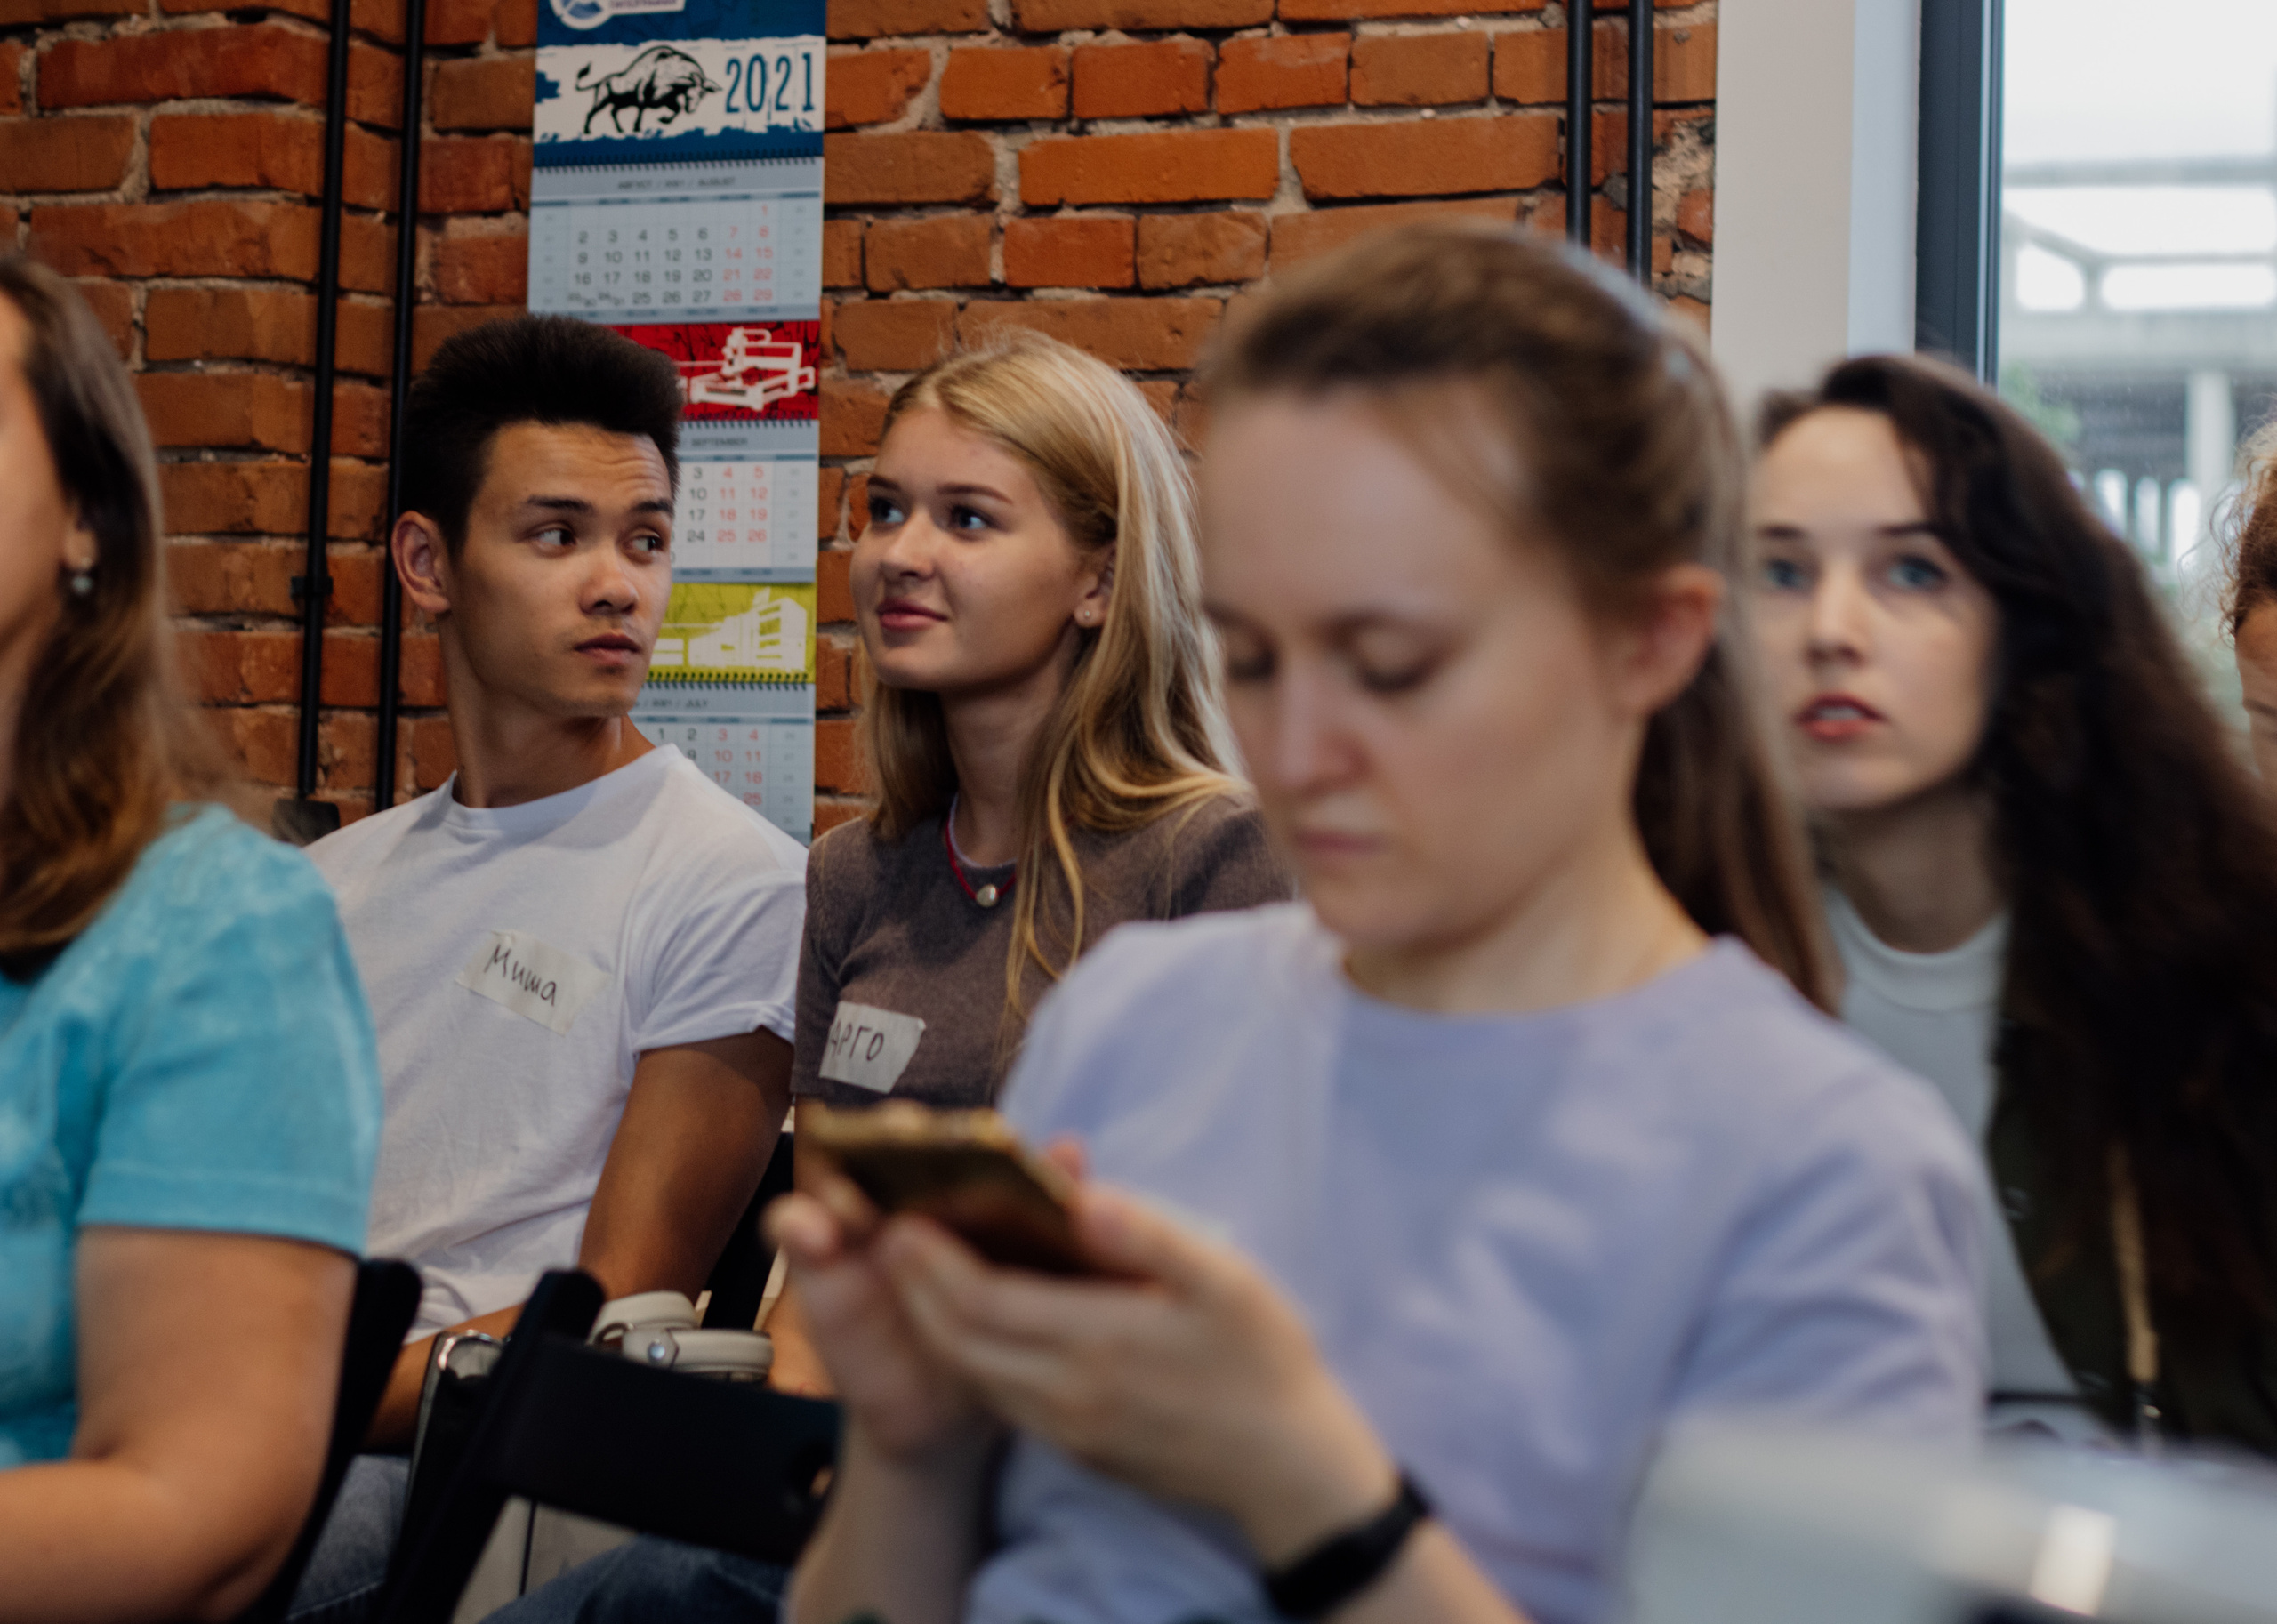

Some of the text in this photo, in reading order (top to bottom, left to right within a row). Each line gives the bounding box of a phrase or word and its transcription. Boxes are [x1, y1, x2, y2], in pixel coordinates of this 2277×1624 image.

[725, 52, 815, 114] 2021
[577, 230, 589, 245] 2
[608, 229, 618, 244] 3
[638, 229, 648, 242] 4
[668, 228, 679, 242] 5
[697, 227, 708, 241] 6
[729, 225, 739, 239] 7
[577, 246, 774, 266] 9 10 11 12 13 14 15
[574, 272, 591, 286] 16
[603, 270, 621, 284] 17
[664, 269, 682, 284] 19
[692, 269, 712, 283] 20
[722, 268, 741, 283] 21
[632, 292, 651, 306] 25
[691, 290, 712, 304] 27
[693, 465, 764, 480] 3 4 5
[689, 486, 768, 501] 10 11 12
[688, 507, 768, 522] 17 18 19
[686, 529, 706, 543] 24
[716, 528, 736, 543] 25
[747, 528, 767, 543] 26
[687, 728, 697, 742] 2
[718, 728, 728, 742] 3
[748, 729, 759, 741] 4
[713, 750, 733, 763] 10
[744, 750, 761, 762] 11
[713, 769, 732, 784] 17
[483, 943, 558, 1008] Миша
